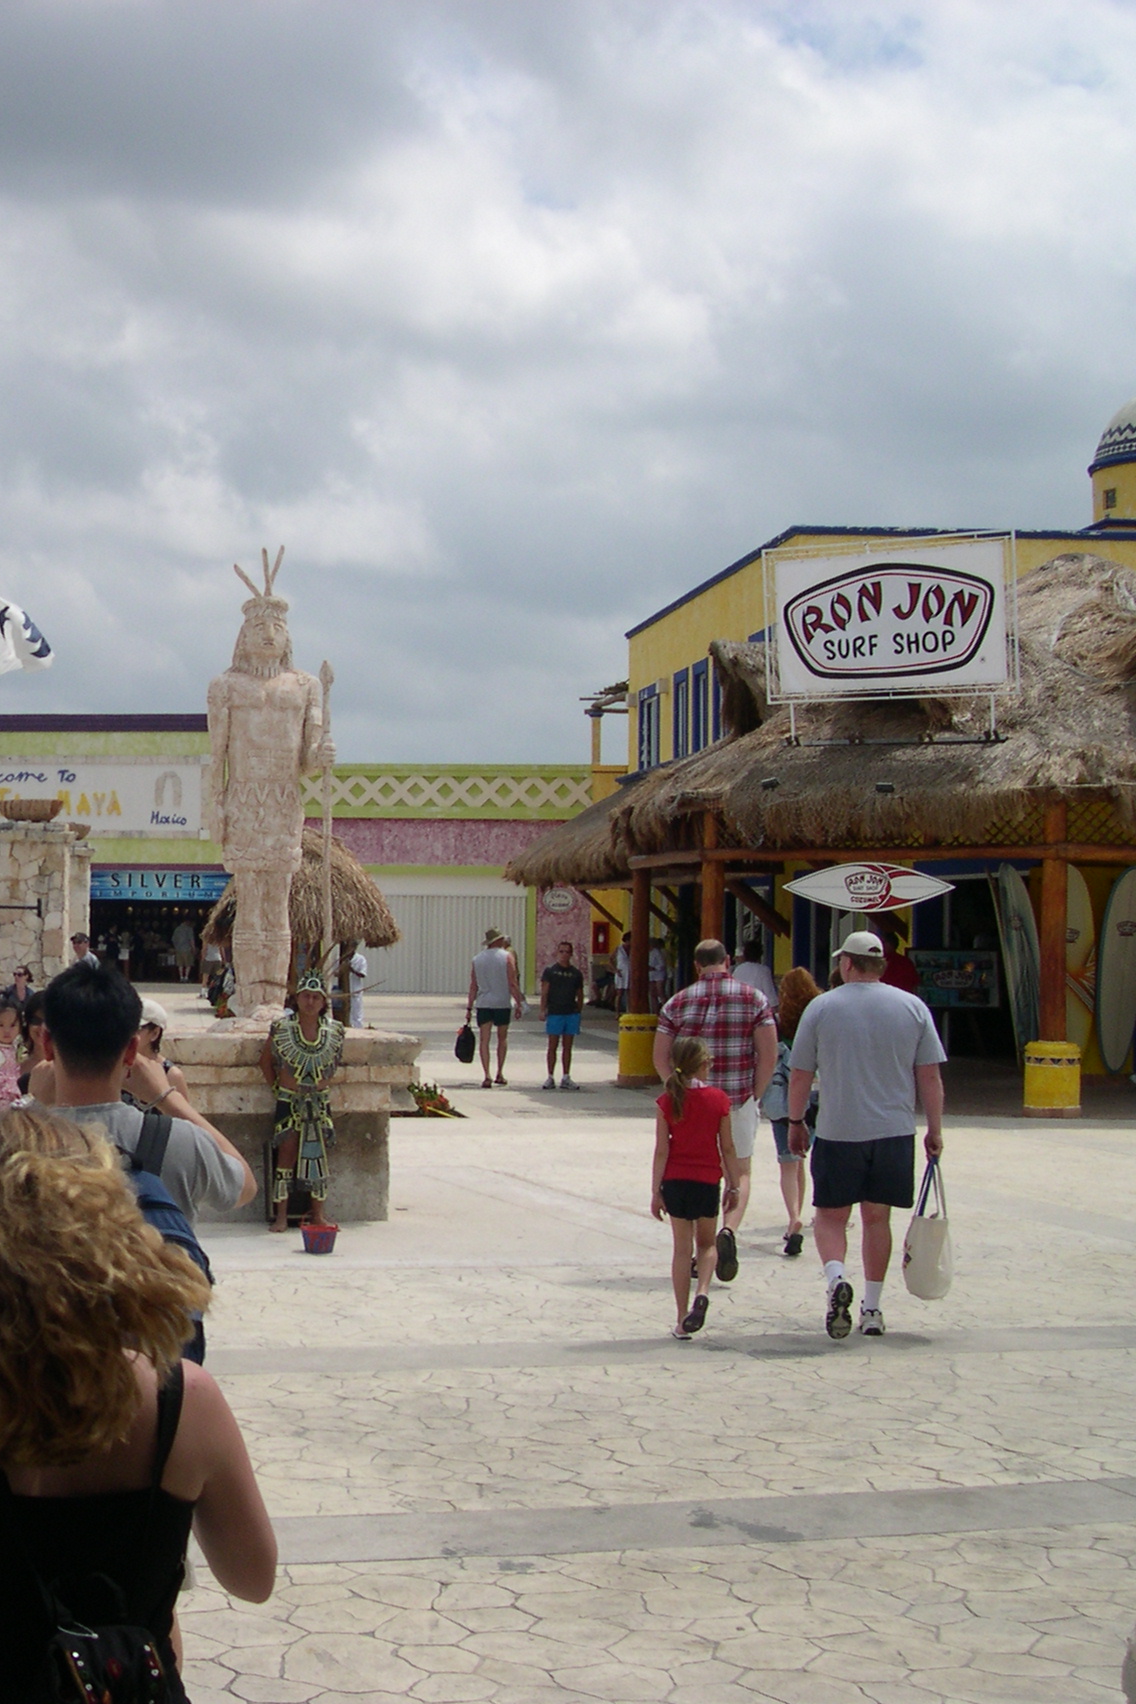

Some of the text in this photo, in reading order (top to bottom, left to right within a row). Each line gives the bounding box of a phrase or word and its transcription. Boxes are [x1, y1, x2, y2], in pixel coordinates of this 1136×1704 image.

[802, 581, 979, 644] RON JON
[823, 629, 955, 660] SURF SHOP
[58, 770, 77, 783] To
[57, 789, 122, 816] MAYA
[150, 811, 187, 826] Mexico
[111, 872, 201, 889] SILVER
